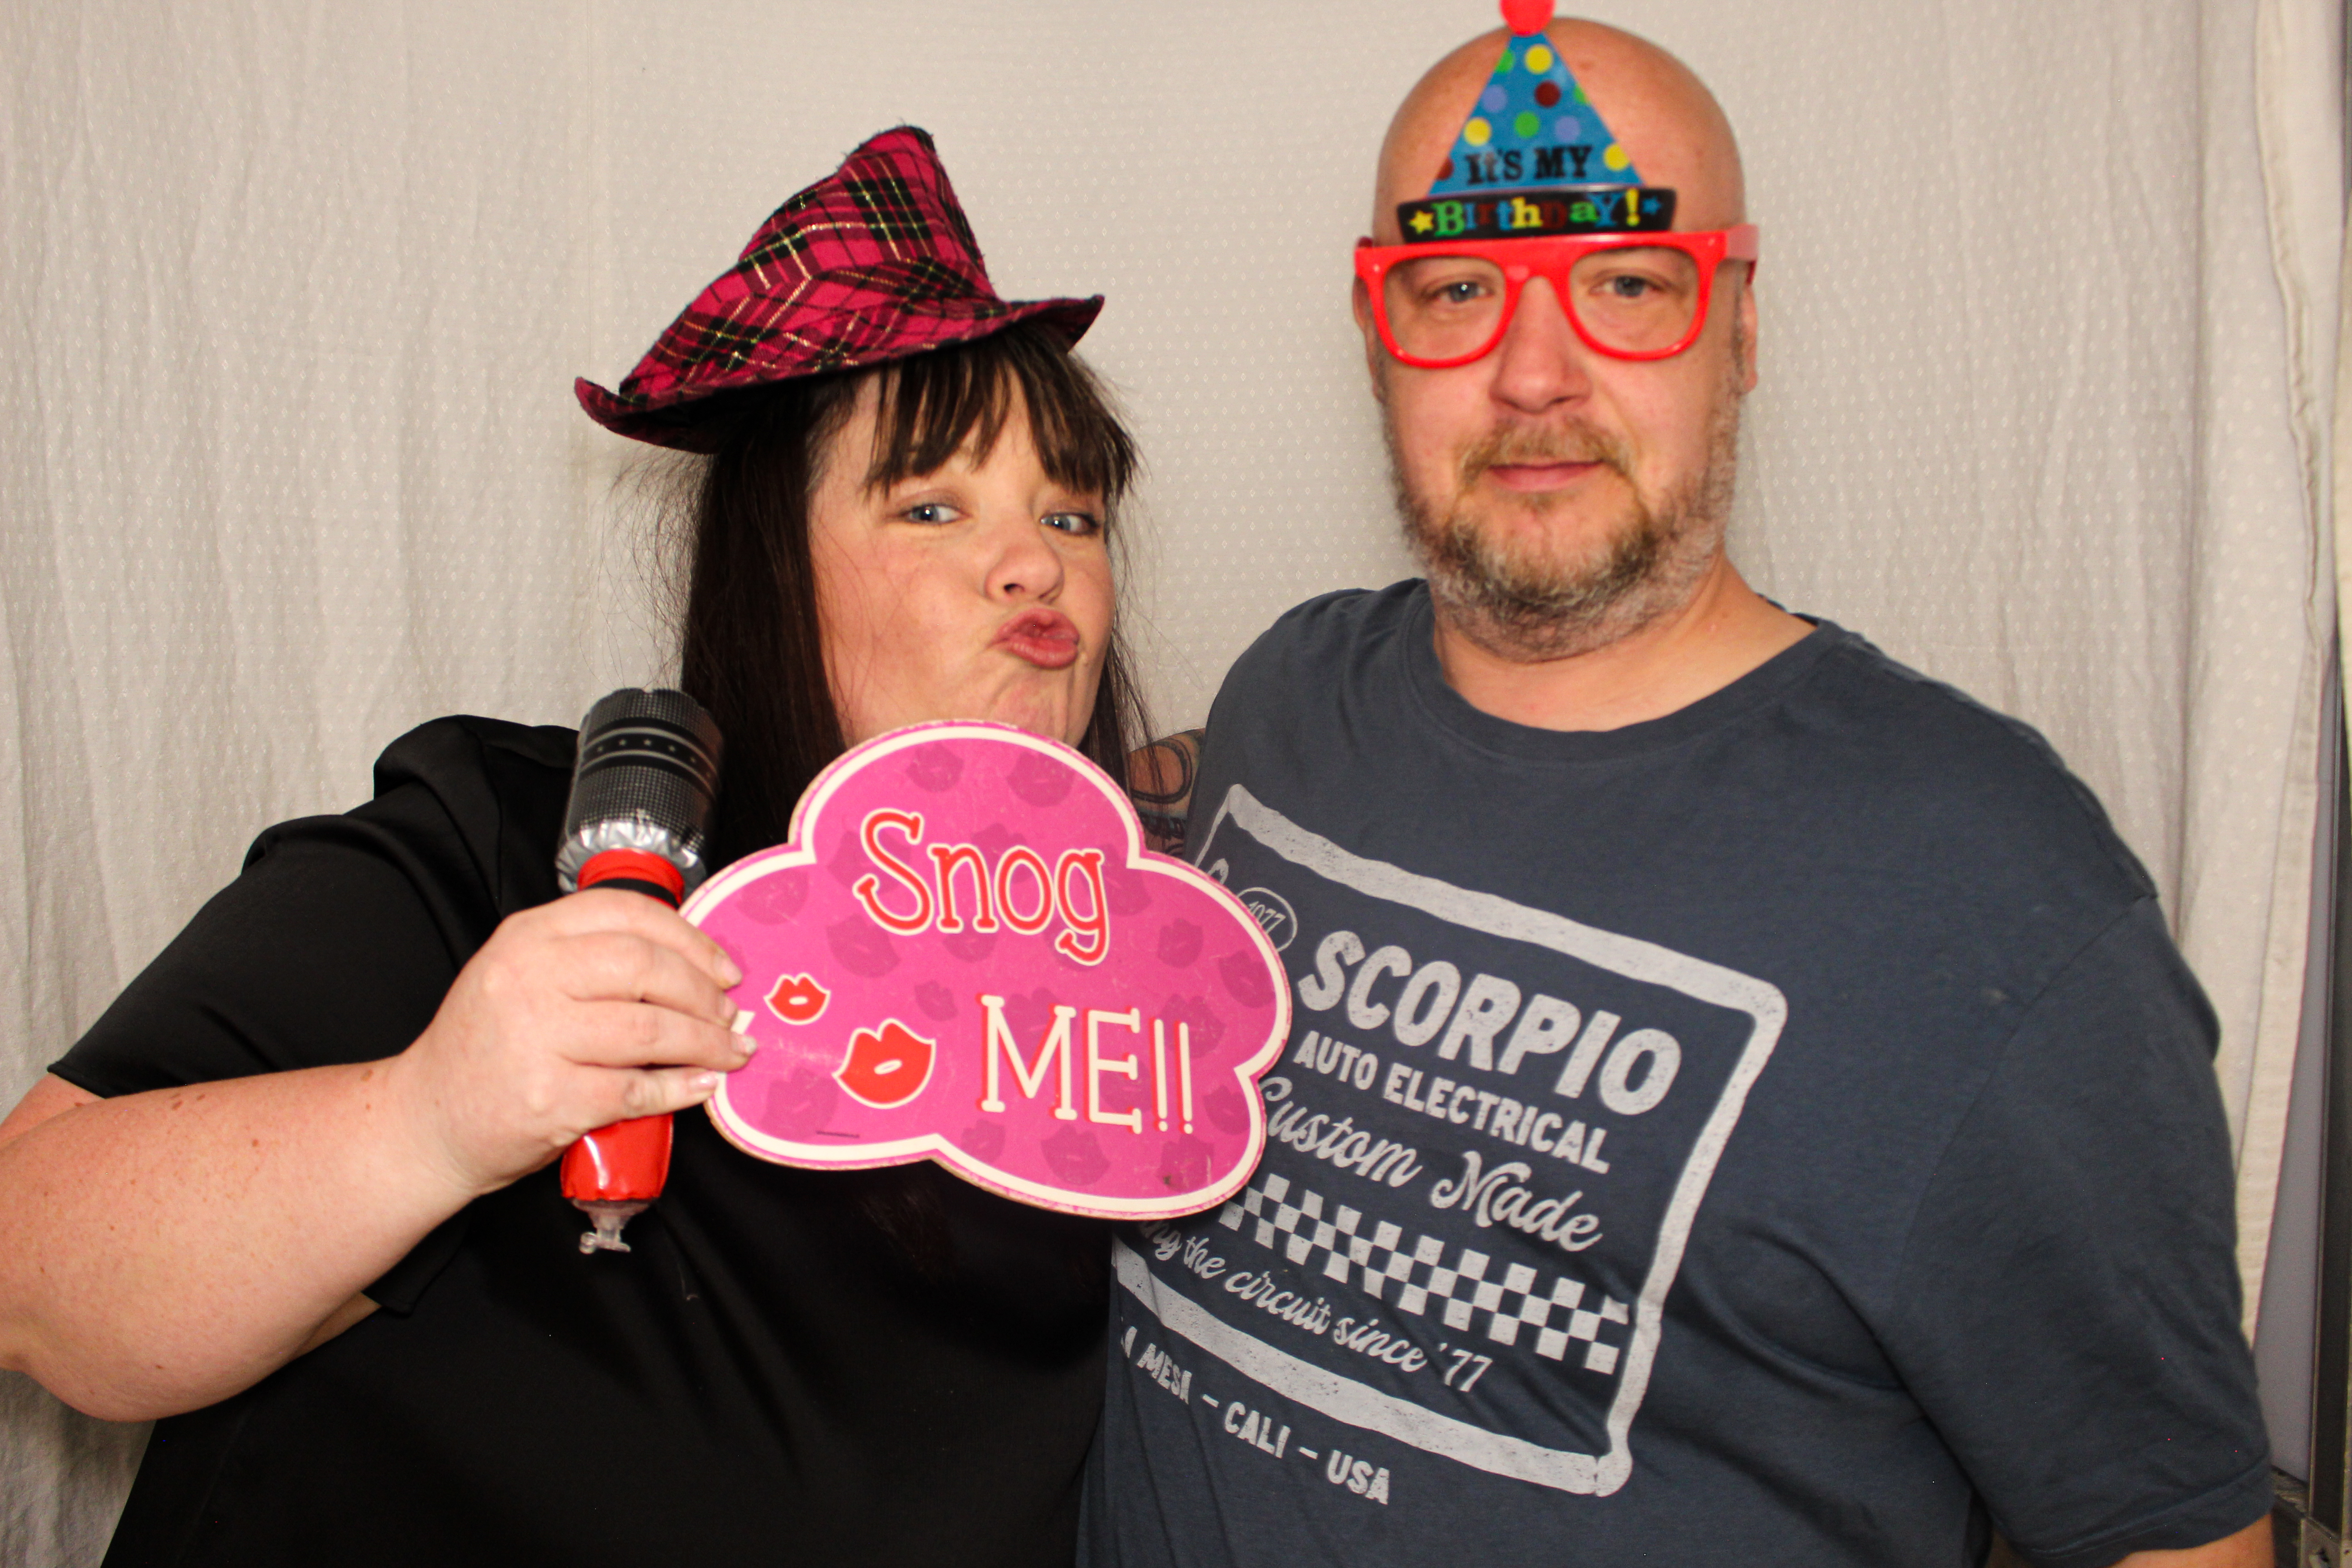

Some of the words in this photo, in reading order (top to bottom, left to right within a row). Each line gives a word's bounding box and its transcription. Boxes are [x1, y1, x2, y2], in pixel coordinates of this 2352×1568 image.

[1534, 144, 1593, 179] MY
[855, 808, 1111, 965] Snog
[975, 993, 1193, 1134] ME!!
[1298, 931, 1681, 1115] SCORPIO
[1258, 1076, 1423, 1187] Custom
[1430, 1151, 1603, 1252] Made
[1294, 1030, 1378, 1090] AUTO
[1382, 1062, 1610, 1174] ELECTRICAL
[1183, 1236, 1226, 1279] the
[1224, 1270, 1332, 1334] circuit
[1333, 1318, 1427, 1372] since
[1439, 1343, 1492, 1392] '77
[1225, 1401, 1291, 1459] CALI
[1326, 1450, 1390, 1505] USA
